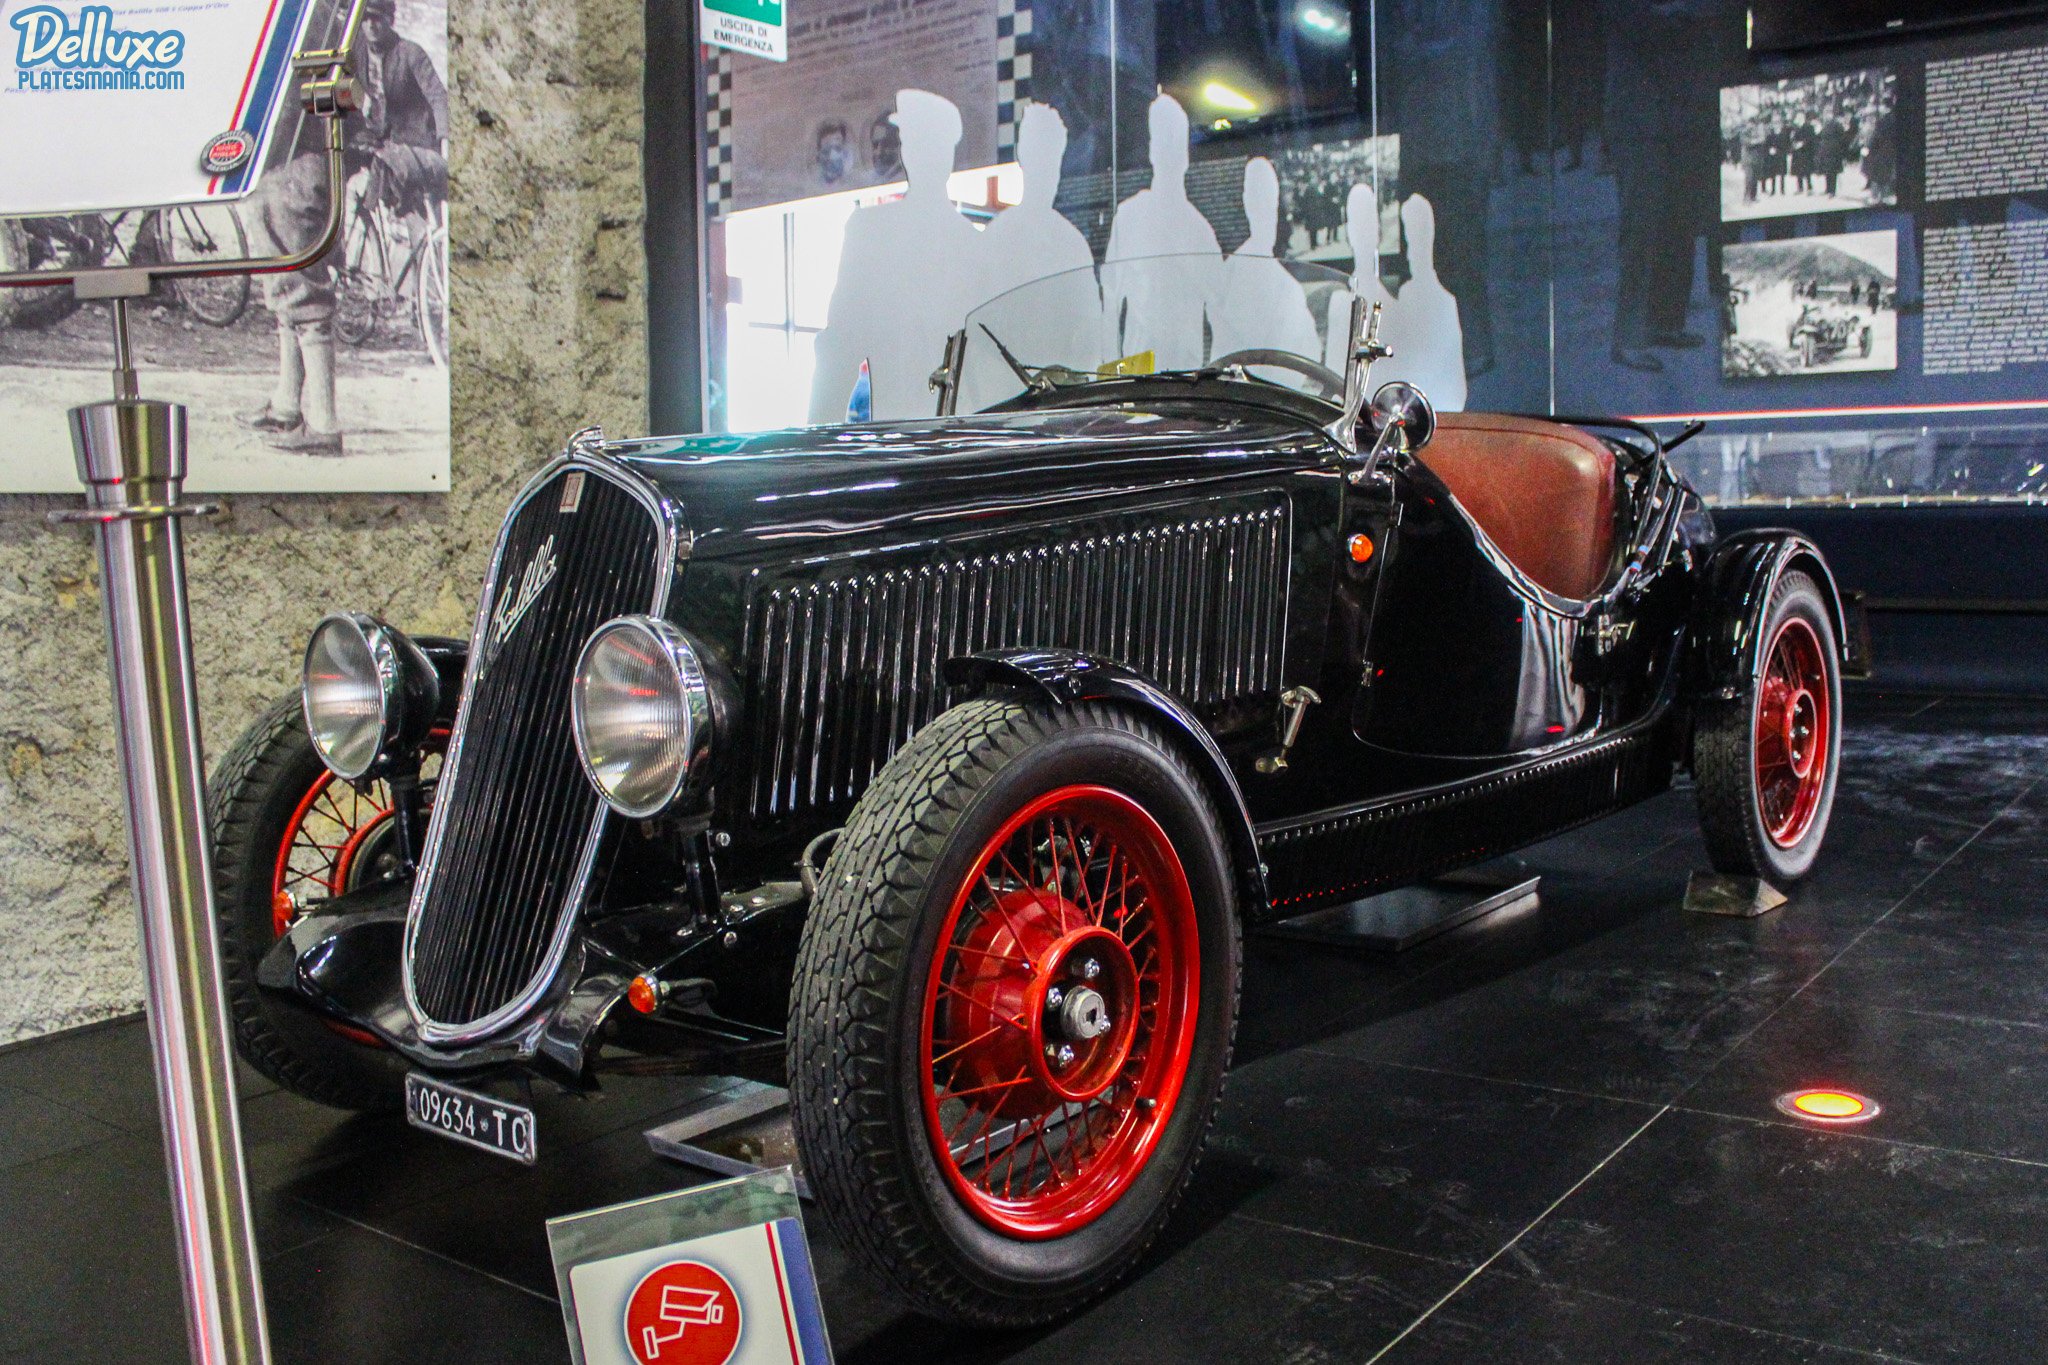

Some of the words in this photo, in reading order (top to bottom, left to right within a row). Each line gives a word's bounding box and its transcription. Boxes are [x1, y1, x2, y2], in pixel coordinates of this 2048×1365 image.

[720, 16, 754, 34] USCITA
[757, 25, 767, 37] DI
[713, 28, 773, 52] EMERGENZA
